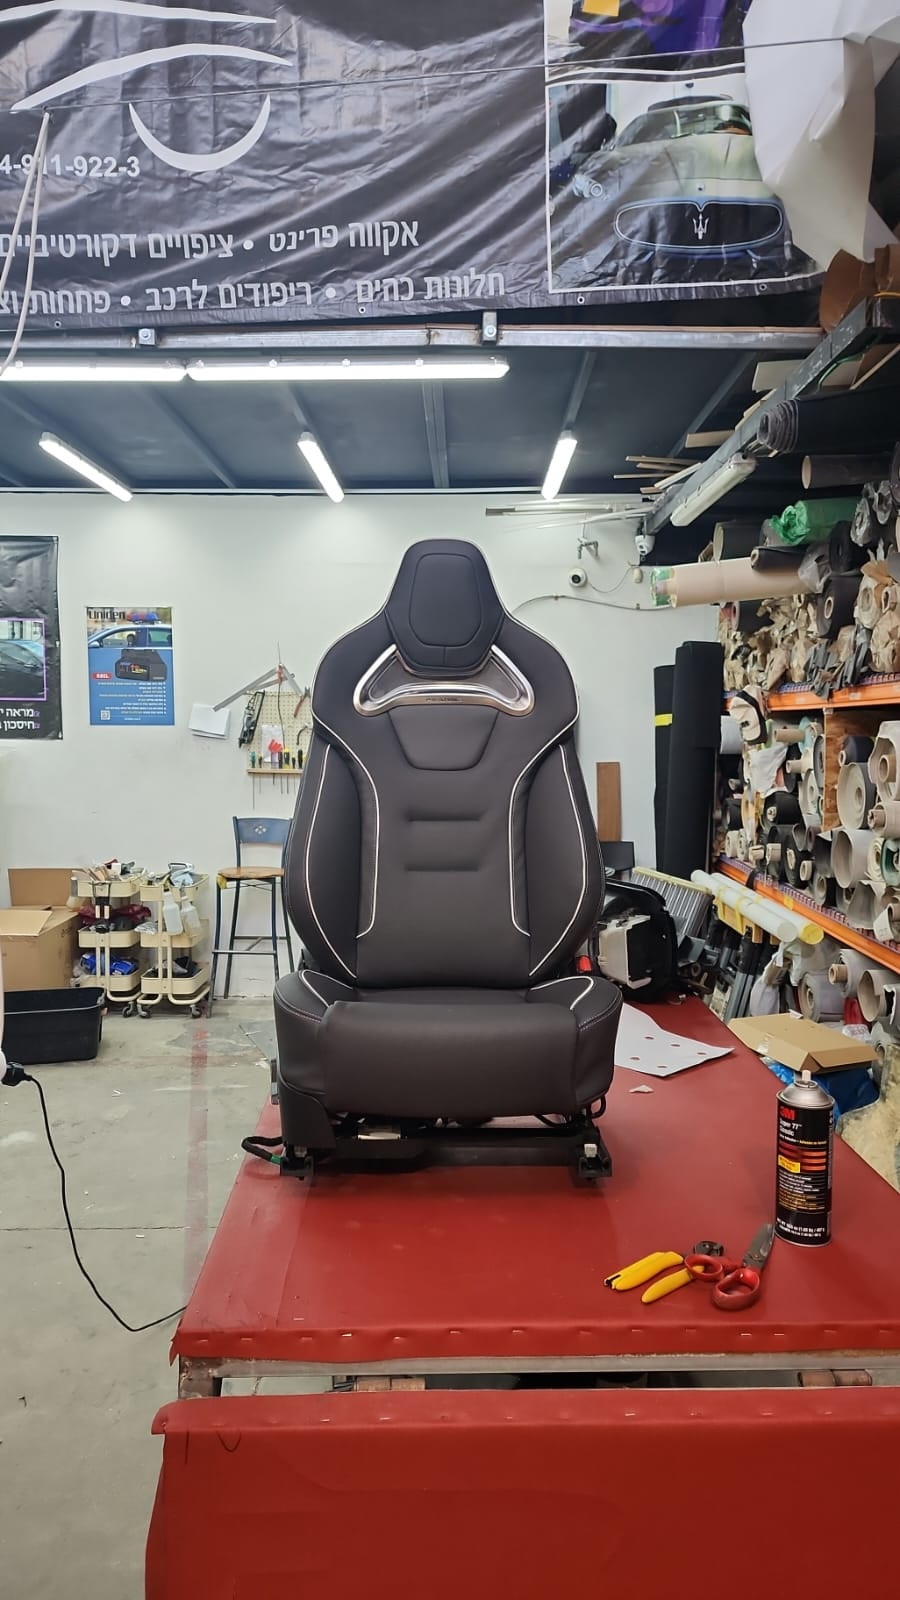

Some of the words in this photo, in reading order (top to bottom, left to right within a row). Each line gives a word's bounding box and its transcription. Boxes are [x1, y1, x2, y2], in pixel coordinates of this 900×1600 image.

[148, 233, 234, 258] ציפויים
[269, 225, 338, 251] פרינט
[348, 220, 419, 255] אקווה
[145, 278, 208, 311] לרכב
[219, 281, 312, 309] ריפודים
[357, 277, 414, 303] כהים
[424, 267, 505, 300] חלונות
[29, 289, 111, 314] פחחות
[88, 609, 126, 620] Uniden
[5, 708, 34, 717] מראה
[3, 720, 35, 732] חיסכון
[779, 1106, 796, 1121] 3M
